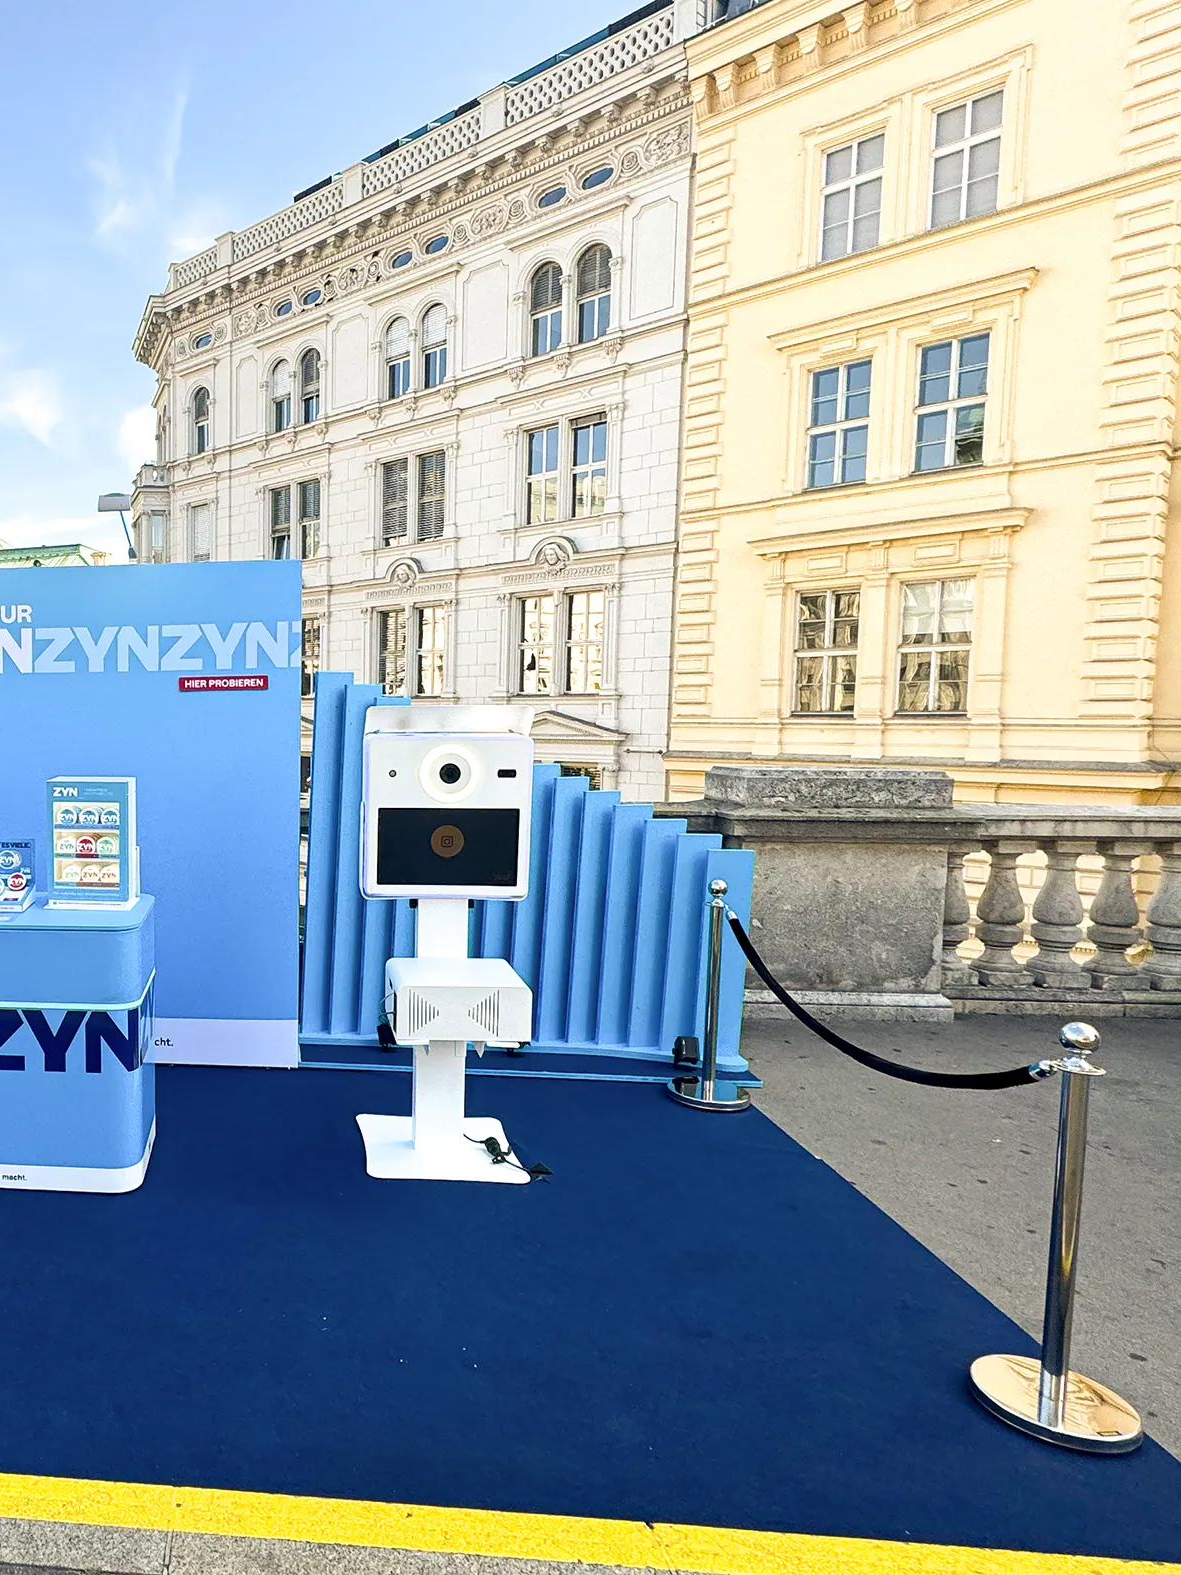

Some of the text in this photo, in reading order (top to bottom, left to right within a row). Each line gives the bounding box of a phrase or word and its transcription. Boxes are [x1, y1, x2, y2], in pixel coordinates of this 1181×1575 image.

[185, 678, 264, 689] HIER PROBIEREN
[52, 787, 78, 797] ZYN
[2, 1173, 28, 1181] macht.
